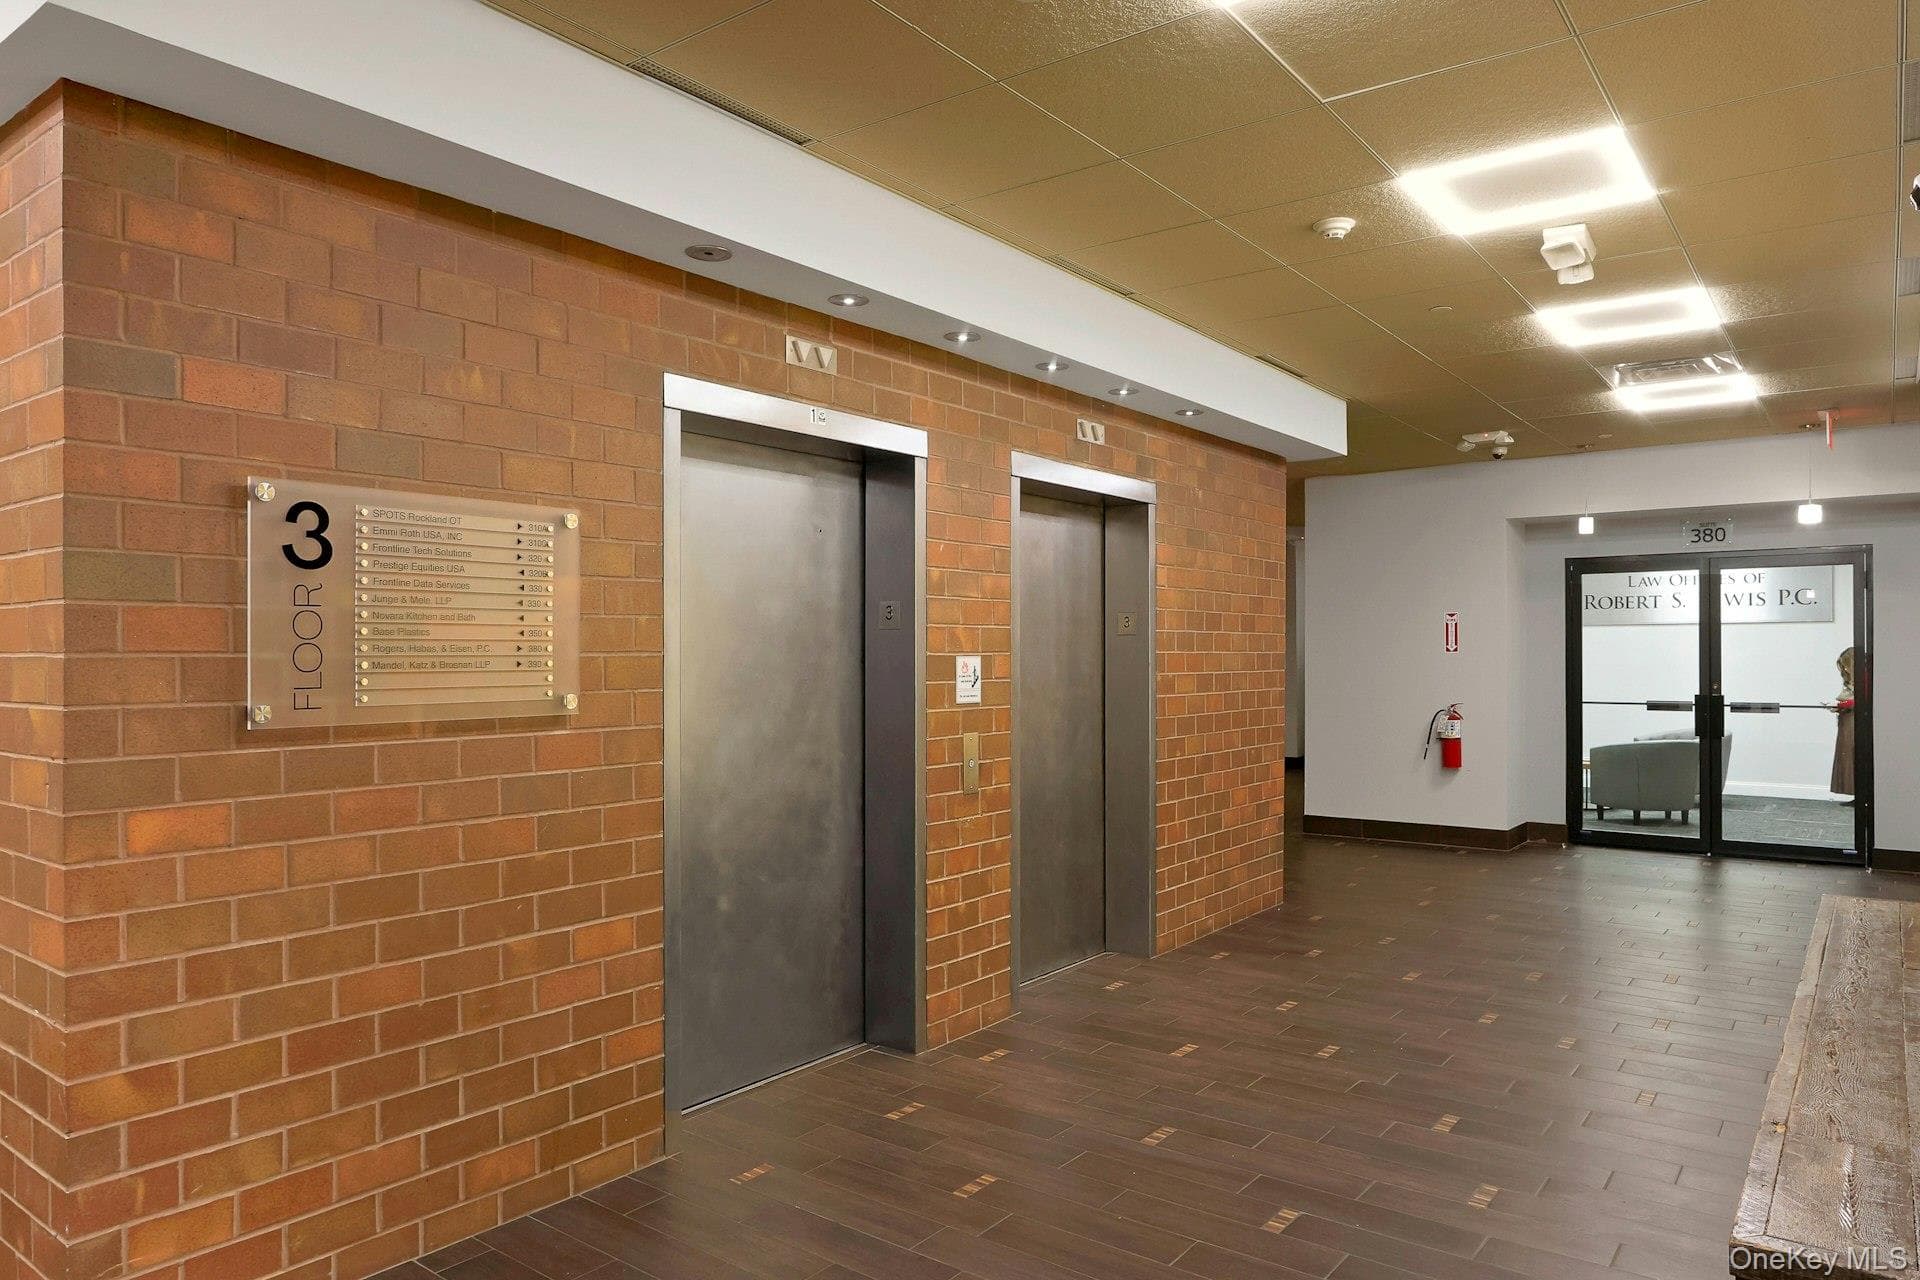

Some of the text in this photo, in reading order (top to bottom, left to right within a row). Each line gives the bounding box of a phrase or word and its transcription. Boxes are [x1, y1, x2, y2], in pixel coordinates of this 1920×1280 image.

[373, 508, 406, 519] SPOTS
[408, 512, 448, 524] Rockland
[449, 516, 463, 525] OT
[282, 500, 334, 570] 3
[373, 526, 398, 536] Emmi
[400, 528, 420, 538] Roth
[423, 531, 444, 541] USA,
[447, 532, 463, 541] INC
[1690, 527, 1726, 543] 380
[372, 544, 542, 562] Frontline Tech Solutions 320
[373, 560, 408, 572] Prestige
[412, 562, 444, 573] Equities
[446, 564, 466, 573] USA
[373, 577, 411, 587] Frontline
[414, 580, 434, 588] Data
[436, 580, 470, 590] Services
[1628, 575, 1662, 588] LAW
[1743, 572, 1767, 584] OF
[372, 594, 399, 605] Junge
[401, 596, 408, 604] &
[436, 597, 452, 605] LLP
[1584, 594, 1662, 610] ROBERT
[1671, 592, 1686, 609] S.
[1778, 588, 1818, 606] P.C.
[372, 611, 476, 622] Novara Kitchen and Bath
[885, 604, 894, 621] 3
[1123, 616, 1130, 628] 3
[372, 627, 395, 636] Base
[398, 627, 430, 636] Plastics
[292, 582, 322, 710] FLOOR
[372, 644, 406, 654] Rogers,
[441, 645, 447, 653] &
[409, 662, 428, 670] Katz
[430, 662, 436, 670] &
[439, 661, 473, 669] Brosnan
[475, 661, 491, 669] LLP
